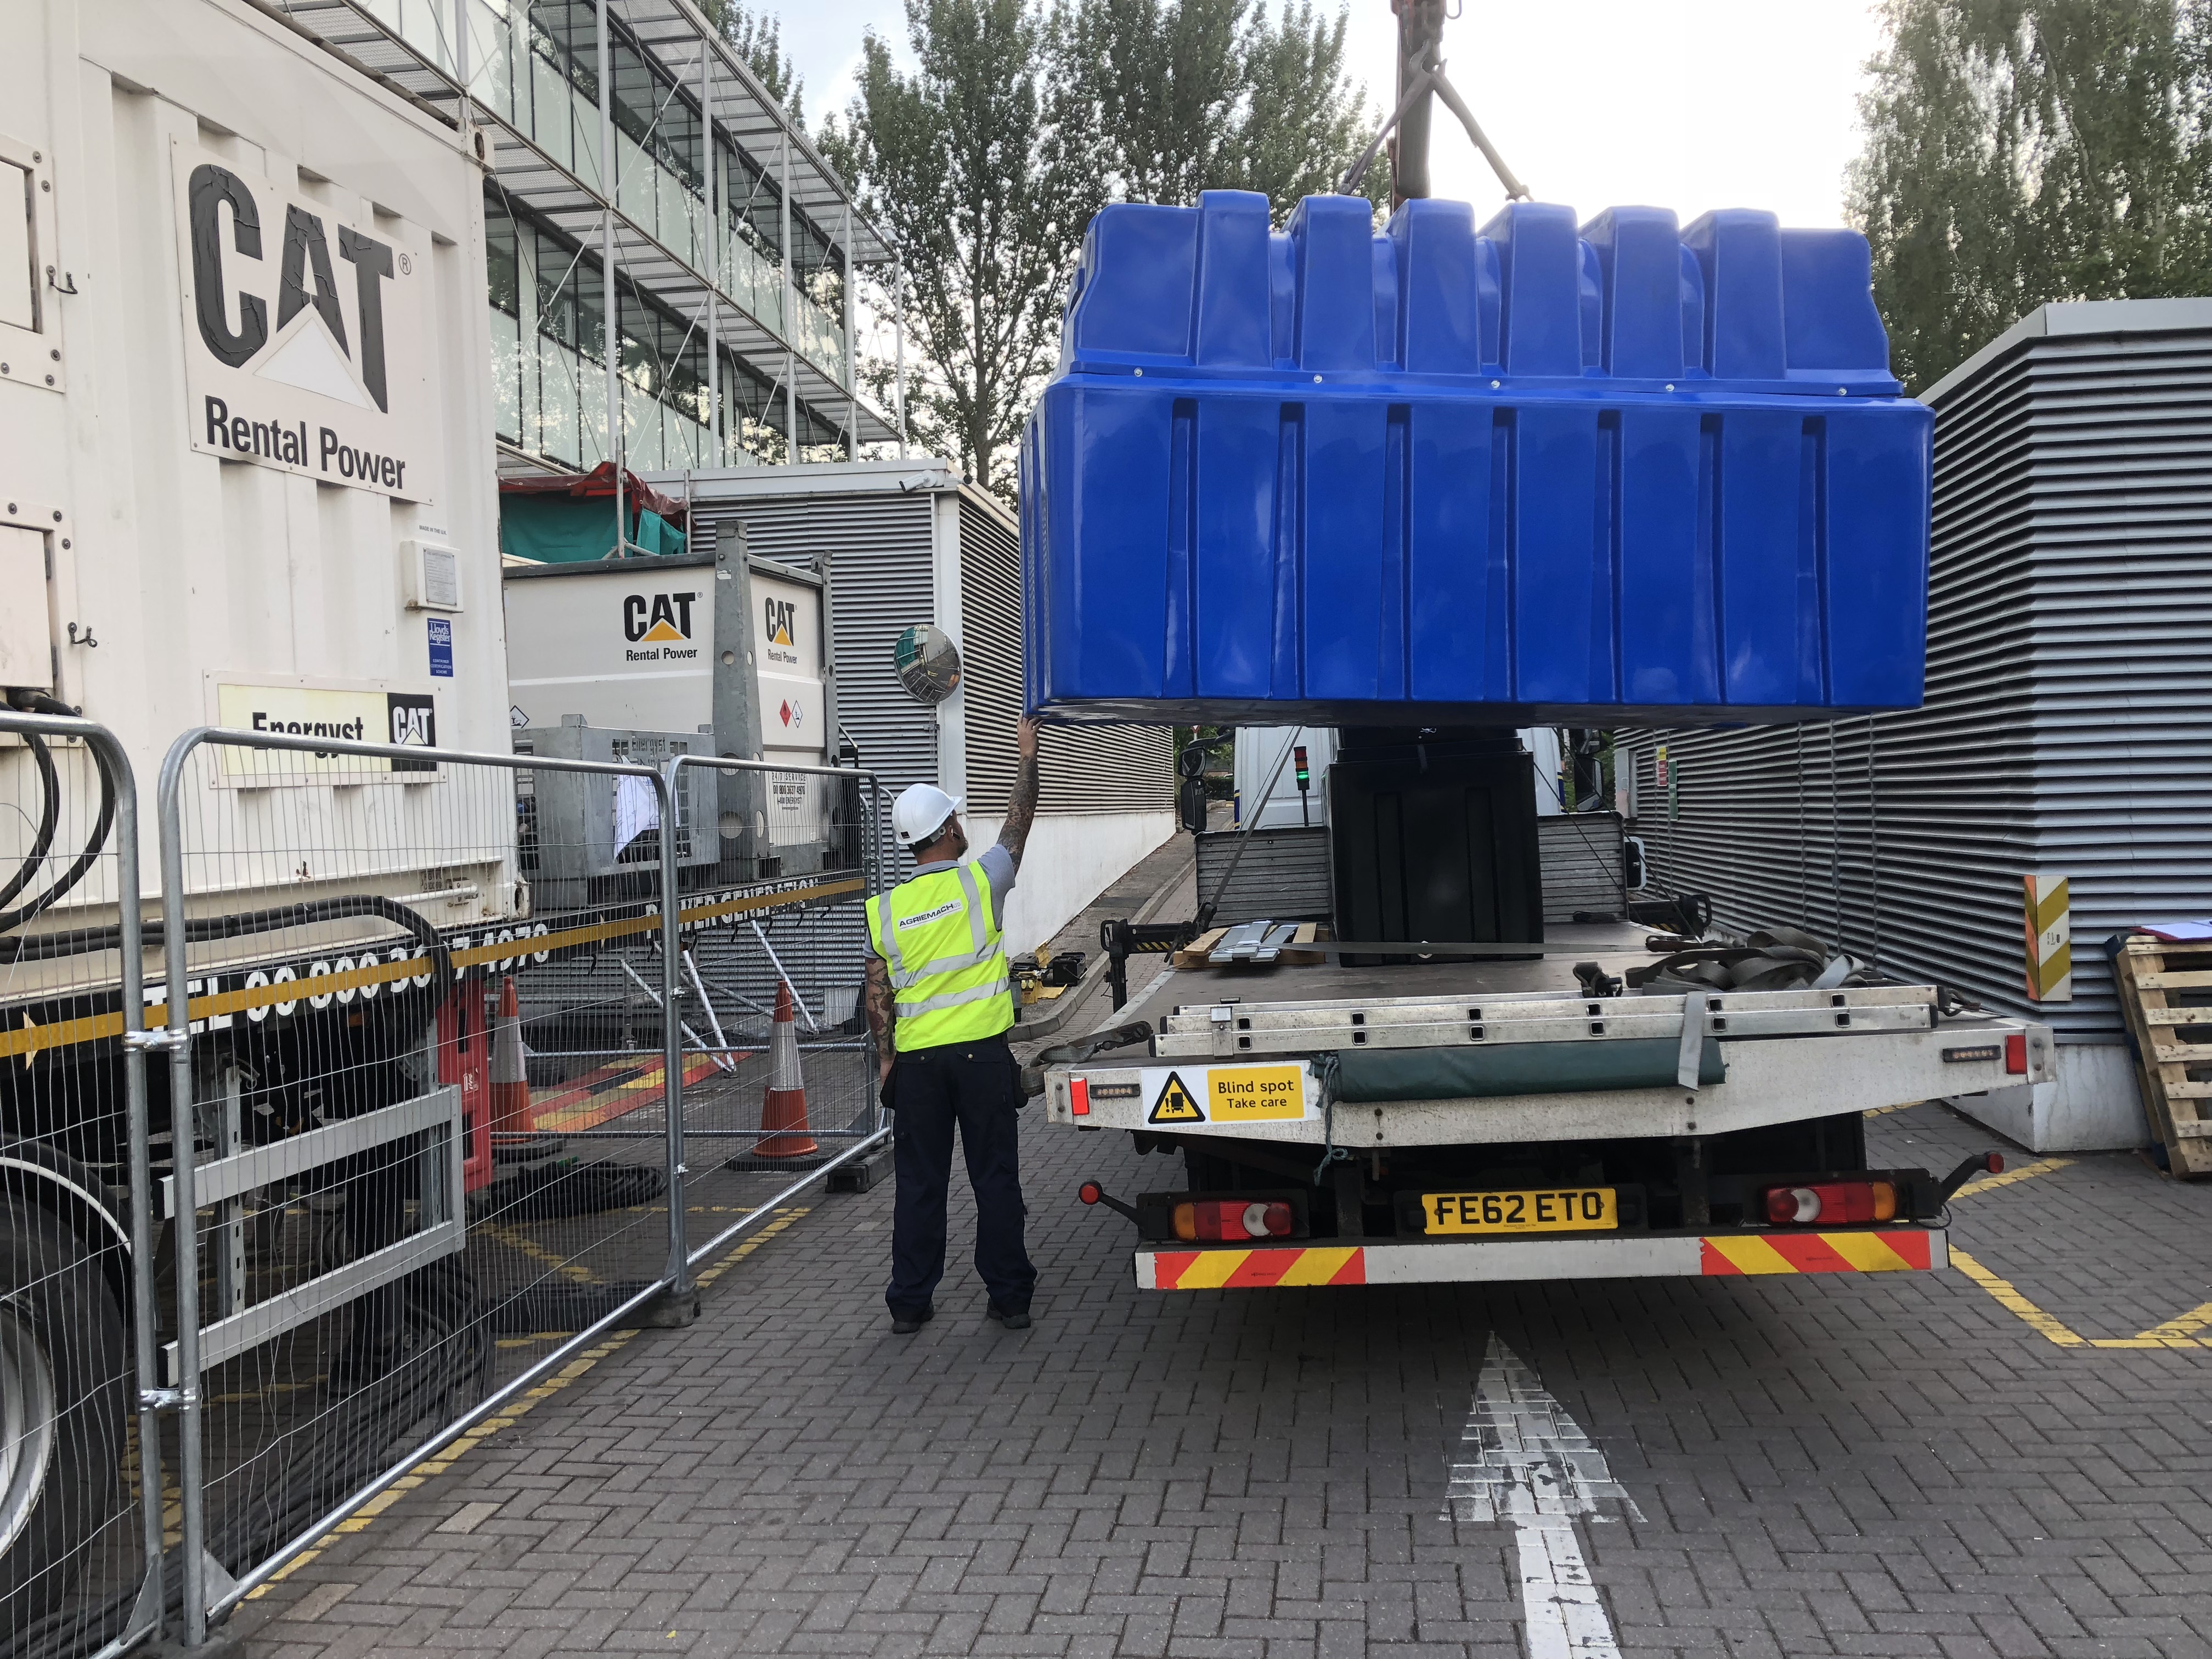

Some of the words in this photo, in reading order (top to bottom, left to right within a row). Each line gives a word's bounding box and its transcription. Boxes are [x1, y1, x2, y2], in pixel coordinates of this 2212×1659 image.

[189, 163, 394, 414] CAT
[205, 394, 308, 467] Rental
[319, 426, 405, 489] Power
[430, 623, 449, 635] Lloyd's
[623, 592, 696, 642] CAT
[765, 597, 794, 647] CAT
[430, 630, 450, 644] Register
[626, 648, 659, 661] Rental
[663, 647, 698, 659] Power
[768, 648, 782, 662] Rental
[783, 651, 797, 664] Power
[393, 706, 430, 745] CAT
[785, 772, 806, 781] SERVICE
[646, 895, 716, 939] PWER
[899, 903, 953, 927] AGRIEMACH
[390, 936, 471, 993] 367
[1218, 1081, 1254, 1094] Blind
[1260, 1080, 1294, 1094] spot
[1227, 1098, 1256, 1108] Take
[1261, 1098, 1287, 1107] care
[1436, 1195, 1526, 1225] FE62
[1536, 1192, 1602, 1222] ETO
